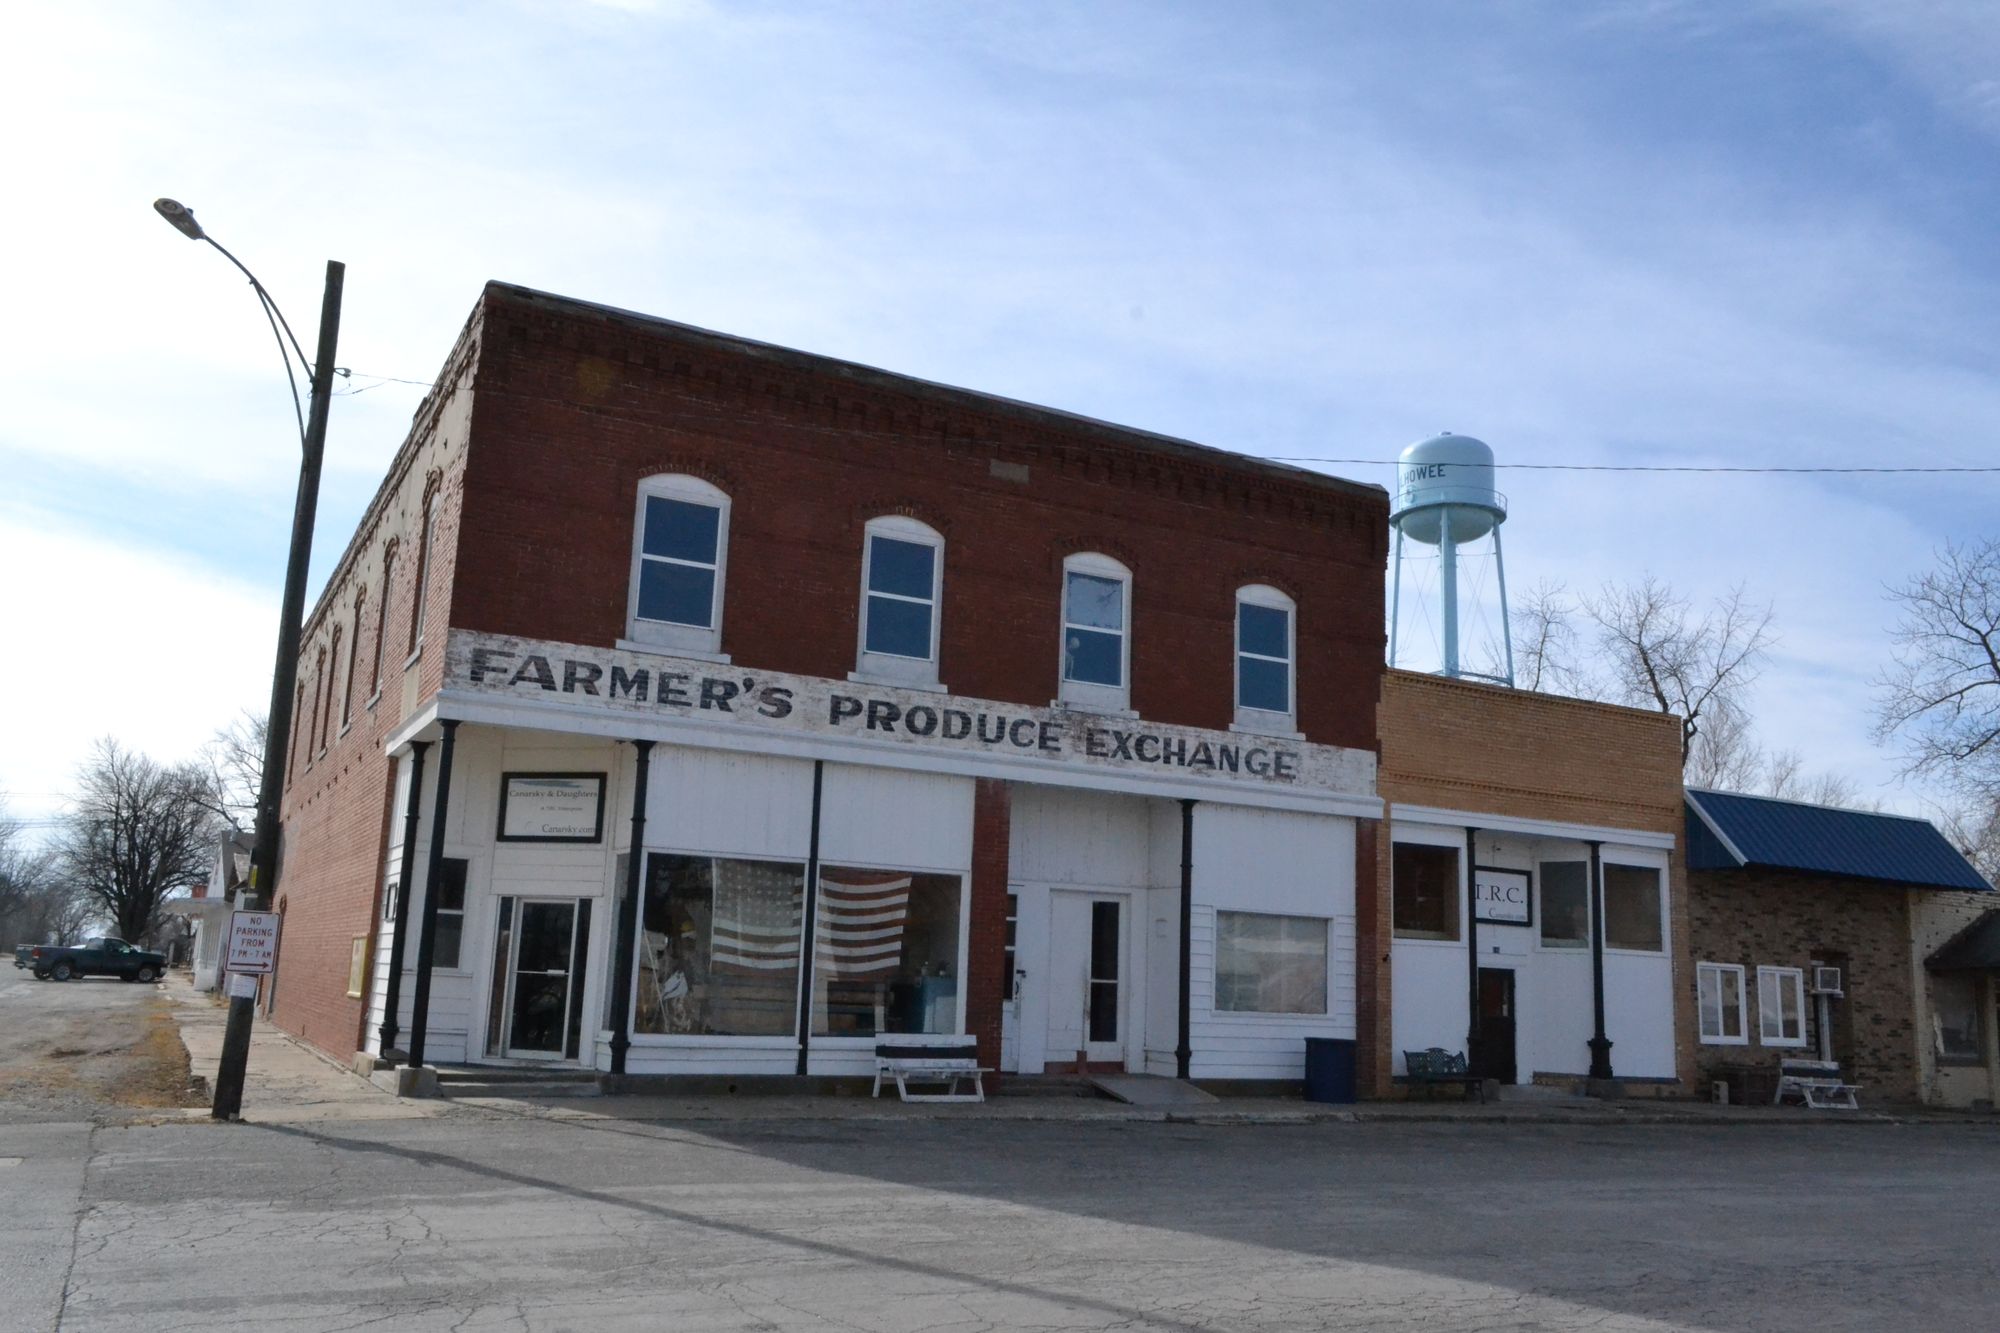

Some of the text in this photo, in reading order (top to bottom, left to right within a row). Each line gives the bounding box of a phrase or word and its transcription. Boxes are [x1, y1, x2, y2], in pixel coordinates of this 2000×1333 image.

[469, 647, 1299, 781] FARMER'S PRODUCE EXCHANGE
[547, 790, 554, 798] &
[556, 789, 598, 800] Daughters
[250, 917, 262, 925] NO
[236, 927, 273, 937] PARKING
[241, 939, 265, 948] FROM
[238, 950, 248, 958] PM
[261, 951, 272, 959] AM
